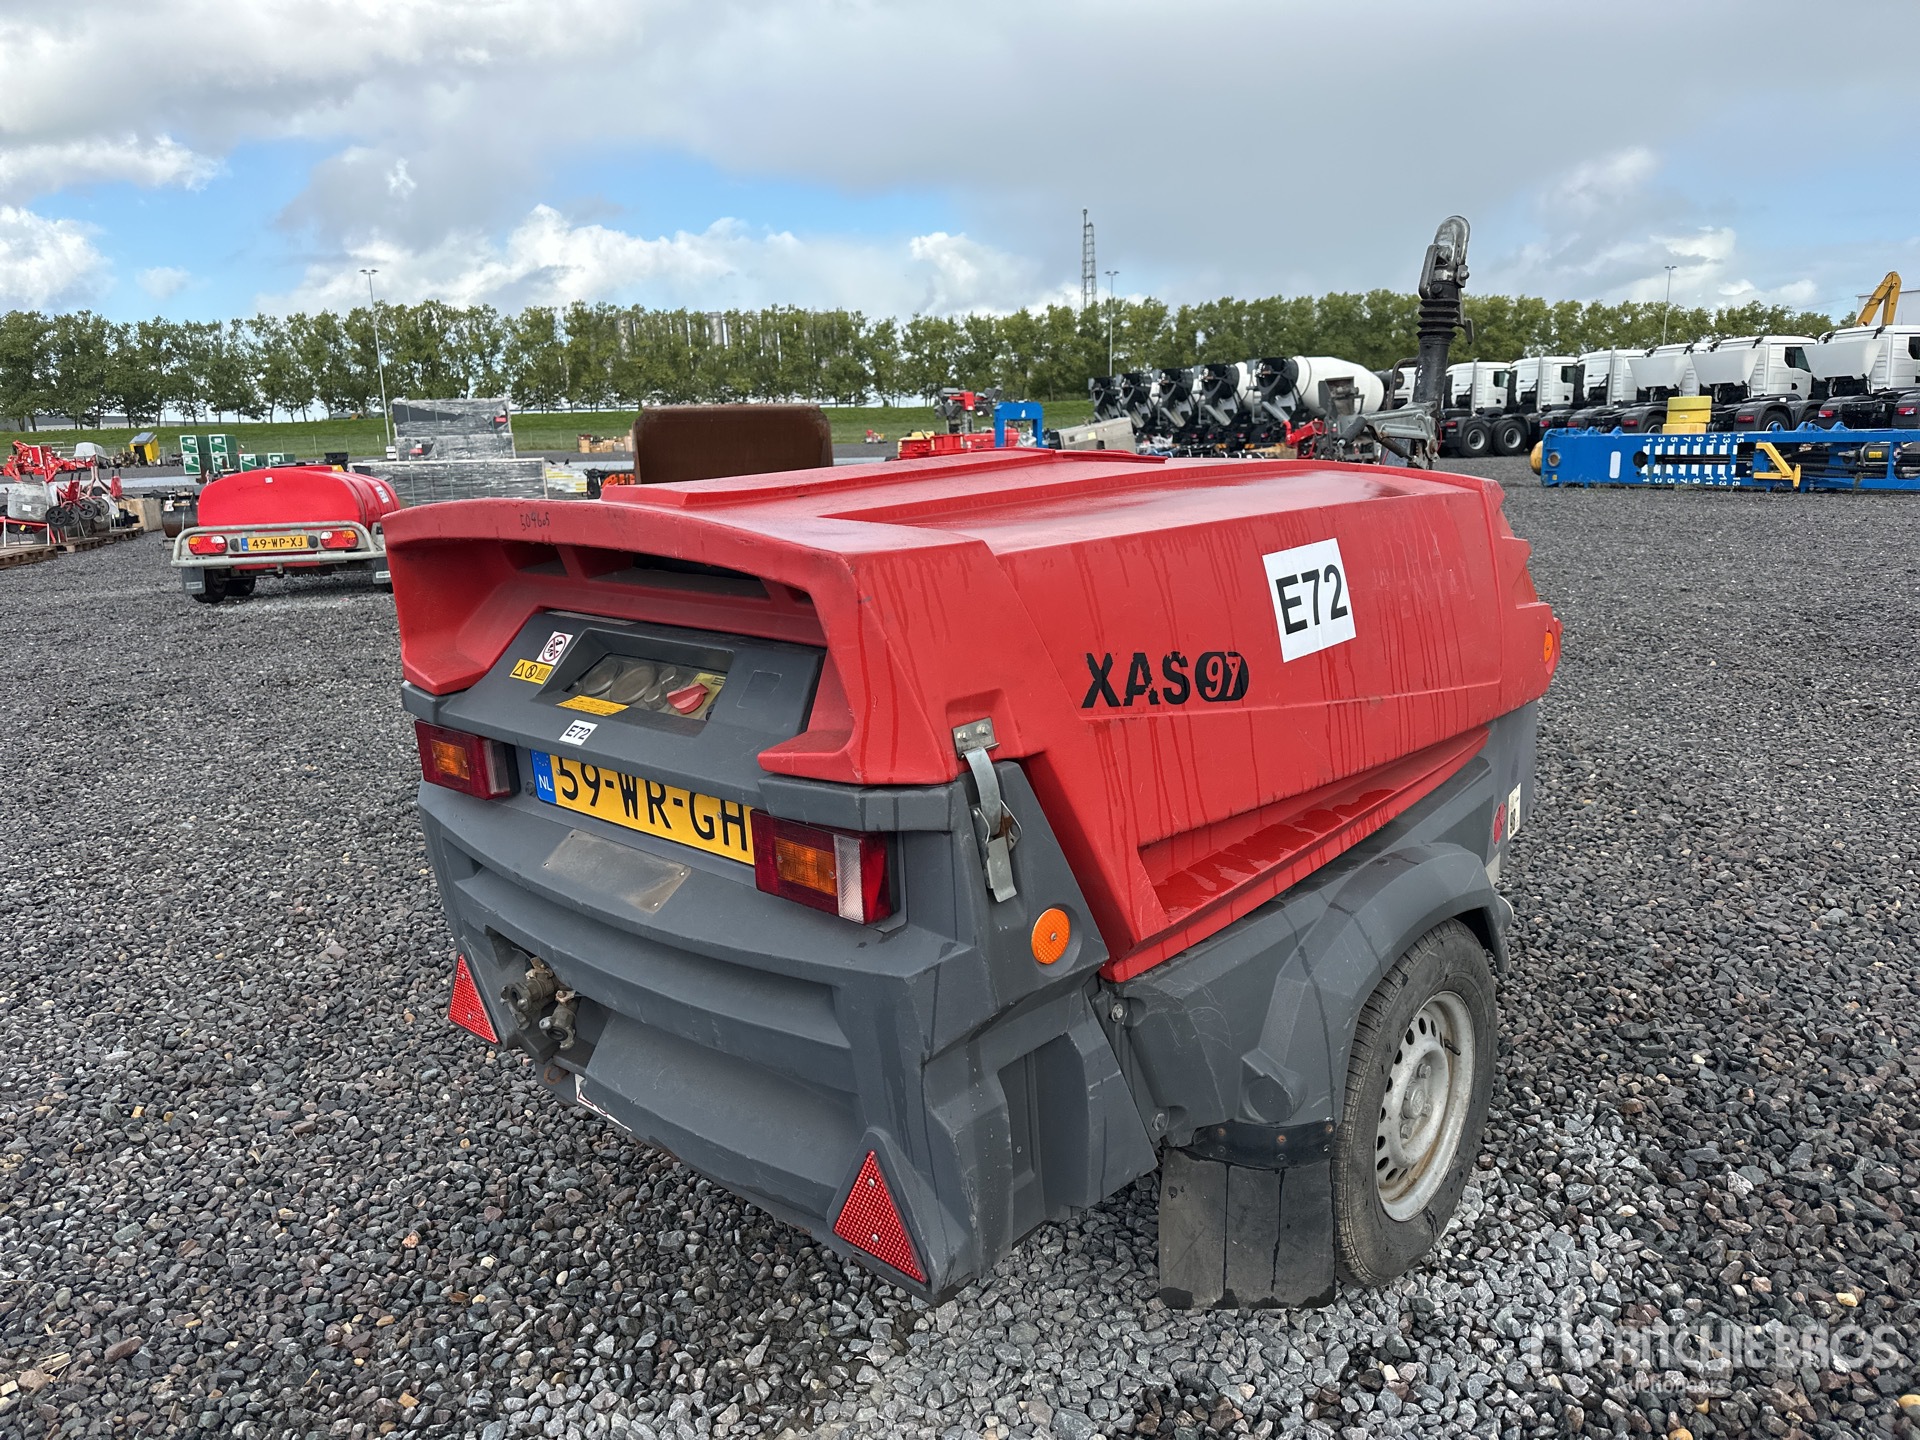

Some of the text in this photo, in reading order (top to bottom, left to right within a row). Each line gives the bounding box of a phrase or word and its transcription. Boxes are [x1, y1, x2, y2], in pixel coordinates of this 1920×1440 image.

[1709, 434, 1717, 443] 11
[1706, 476, 1714, 485] 11
[252, 537, 303, 549] 49-WP-XJ
[1275, 564, 1348, 635] E72
[1081, 651, 1245, 709] XAS 97
[565, 725, 591, 740] E72
[538, 757, 748, 851] NL 59-WR-GH
